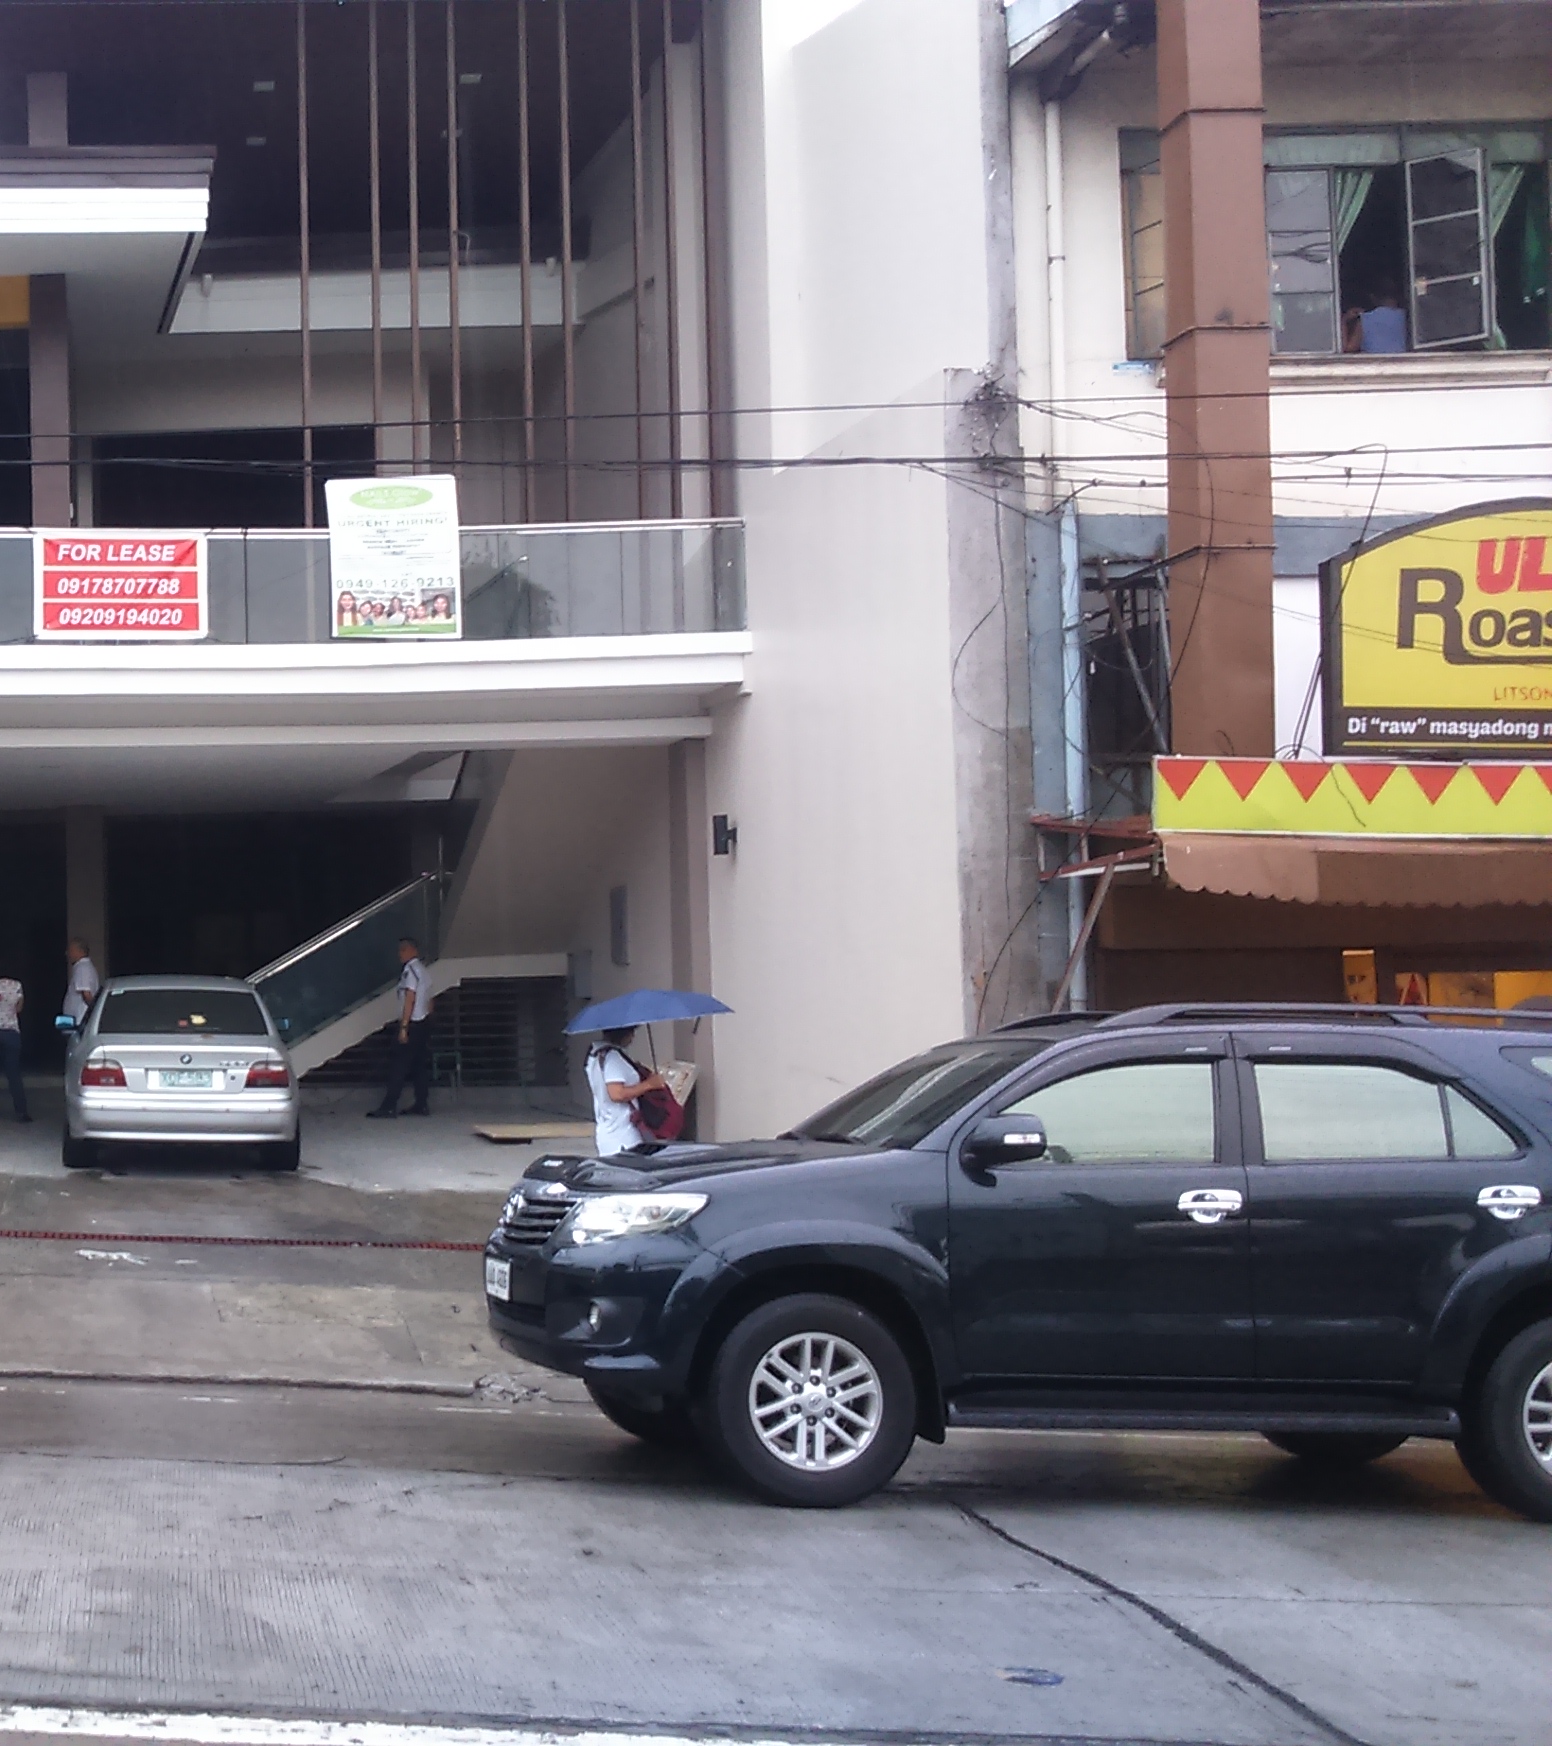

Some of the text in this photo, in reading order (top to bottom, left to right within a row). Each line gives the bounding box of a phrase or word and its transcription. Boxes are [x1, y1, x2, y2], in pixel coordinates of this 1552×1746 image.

[57, 544, 176, 562] FOR LEASE
[57, 577, 180, 595] 09178707788
[59, 607, 183, 625] 09209194020
[1347, 717, 1367, 734] Di
[1429, 719, 1539, 739] masyadong
